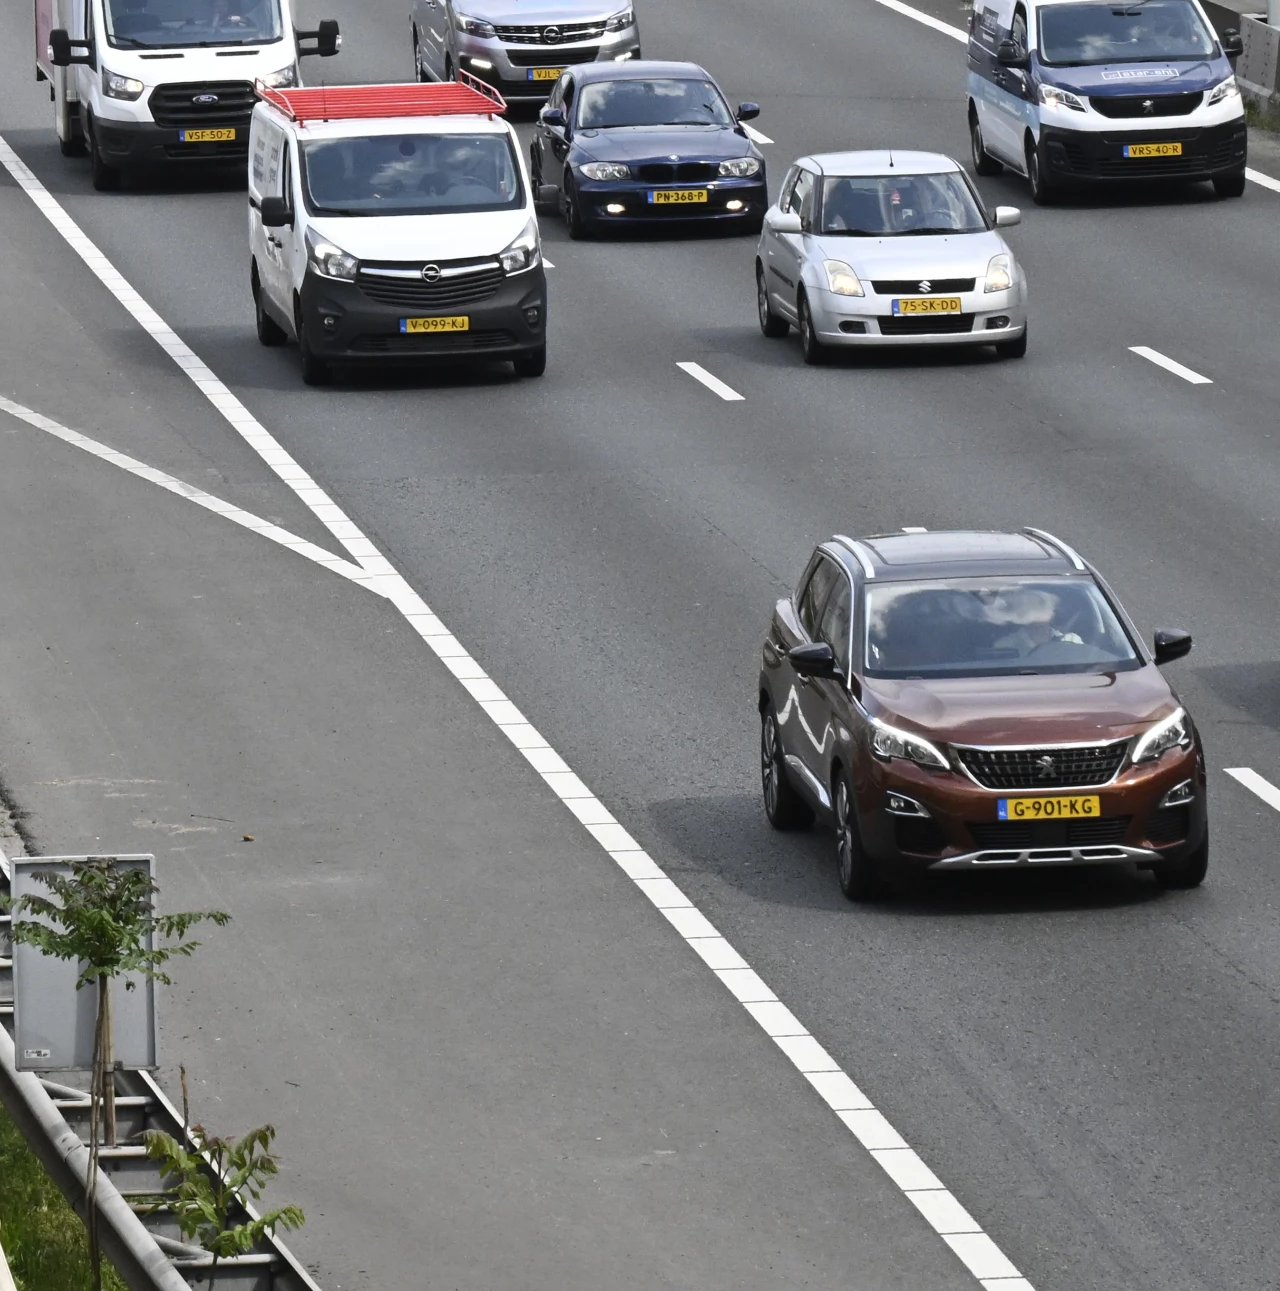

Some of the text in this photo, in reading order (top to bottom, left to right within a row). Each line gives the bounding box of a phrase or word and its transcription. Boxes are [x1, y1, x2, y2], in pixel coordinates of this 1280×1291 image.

[187, 130, 232, 140] VSF-50-Z
[1131, 144, 1179, 156] VRS-40-R
[656, 191, 704, 202] PN-368-P
[903, 300, 958, 313] 75-SK-DD
[410, 318, 465, 331] V-099-KJ
[1014, 799, 1093, 817] G-901-KG
